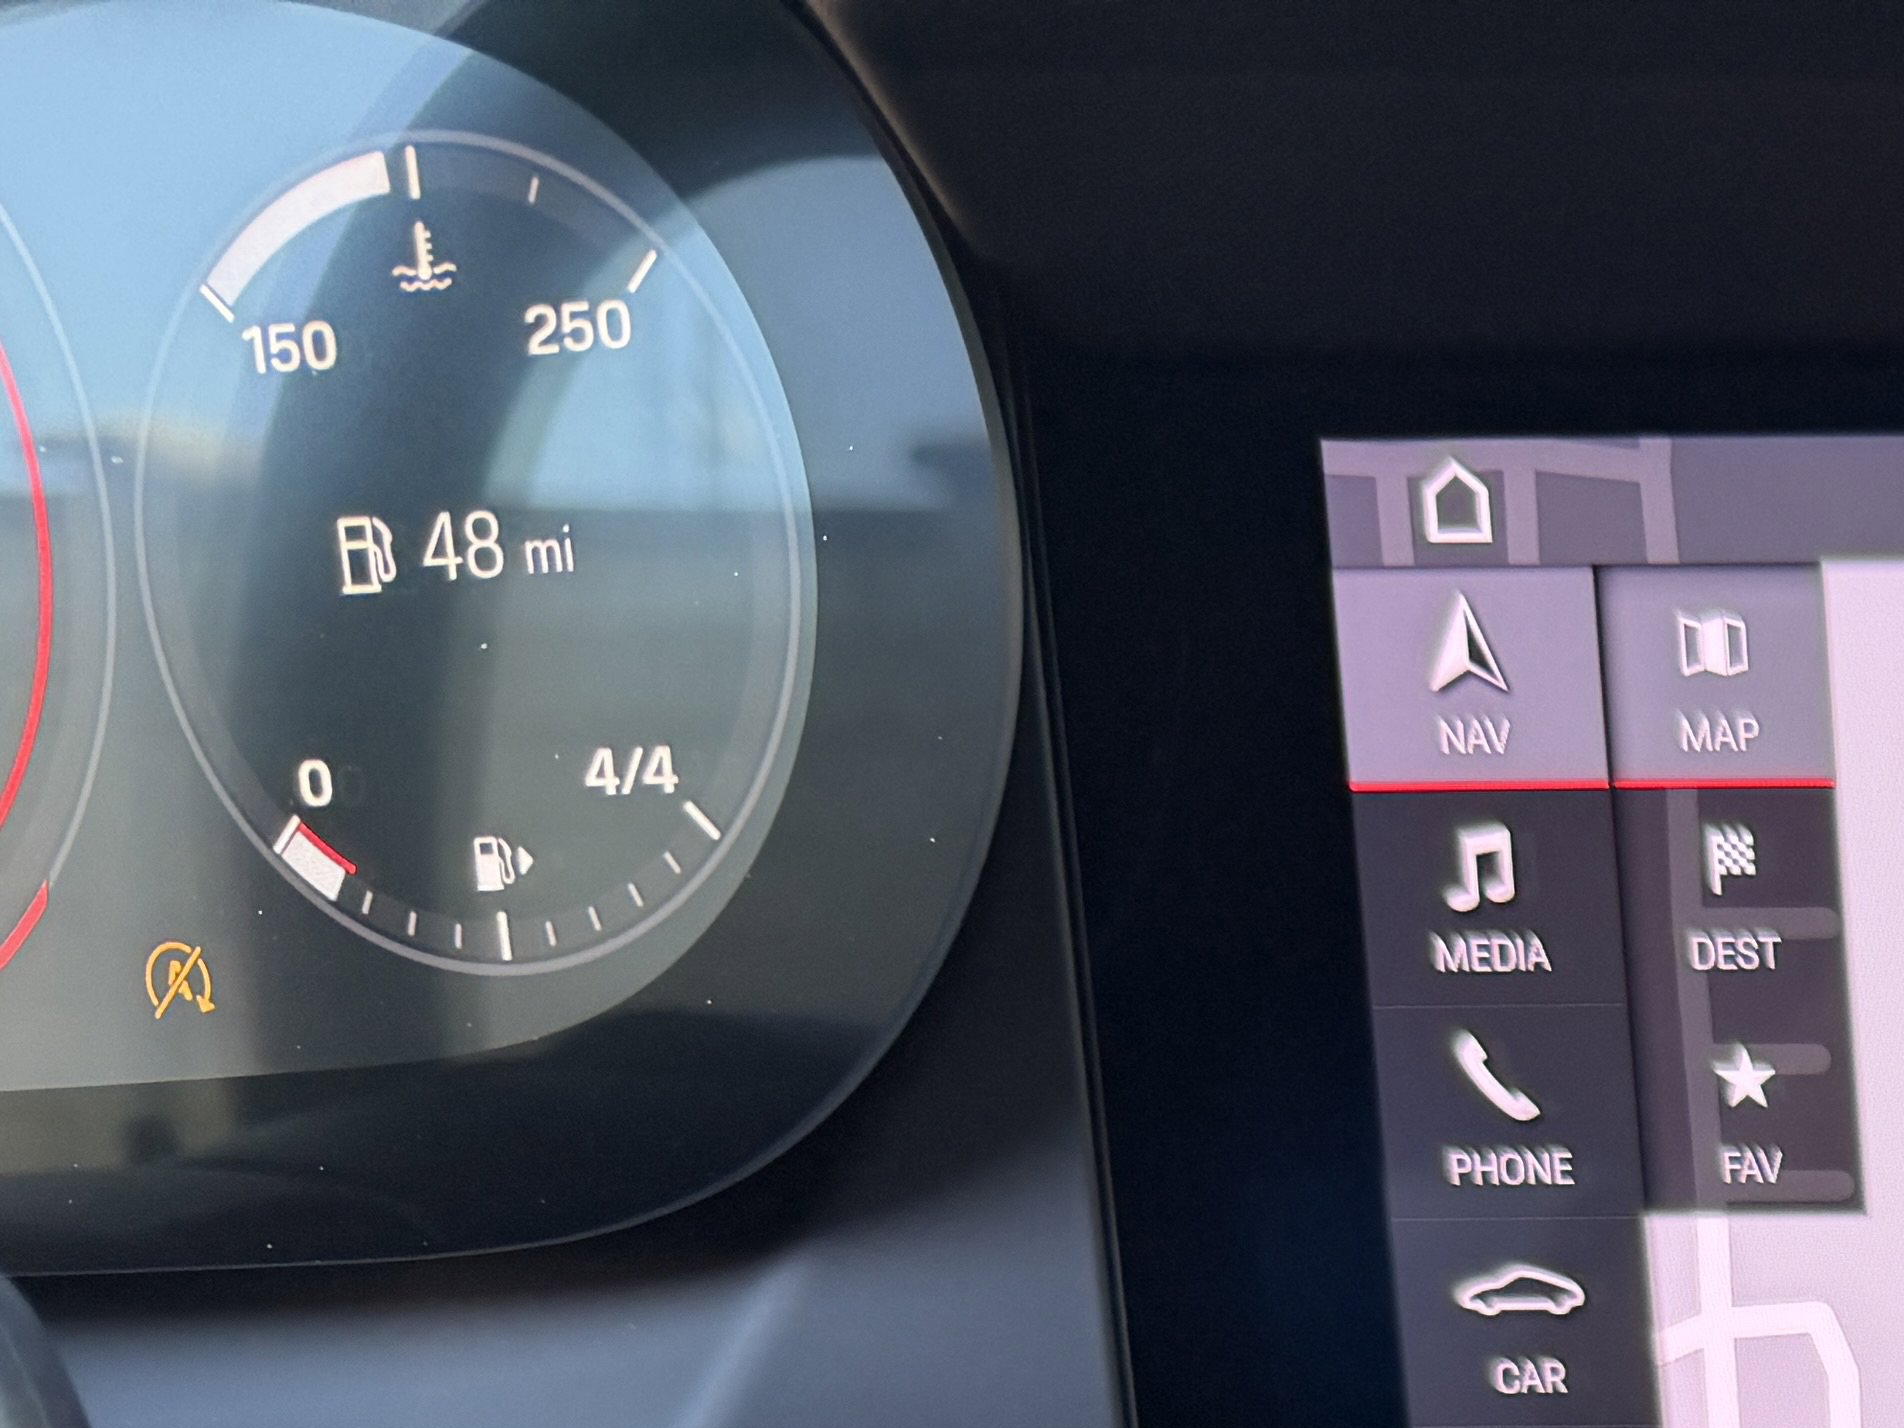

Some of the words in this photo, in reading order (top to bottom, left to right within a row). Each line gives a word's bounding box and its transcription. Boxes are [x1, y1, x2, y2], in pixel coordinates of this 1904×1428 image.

[242, 320, 337, 374] 150
[525, 300, 631, 355] 250
[421, 511, 504, 580] 48
[525, 525, 576, 576] mi
[1437, 718, 1512, 756] NAV
[1676, 717, 1762, 755] MAP
[299, 759, 333, 807] 0
[584, 745, 679, 797] 4/4
[1433, 934, 1553, 974] MEDIA
[1690, 933, 1782, 971] DEST
[1447, 1149, 1575, 1187] PHONE
[1721, 1149, 1784, 1185] FAV
[1490, 1358, 1569, 1395] CAR
